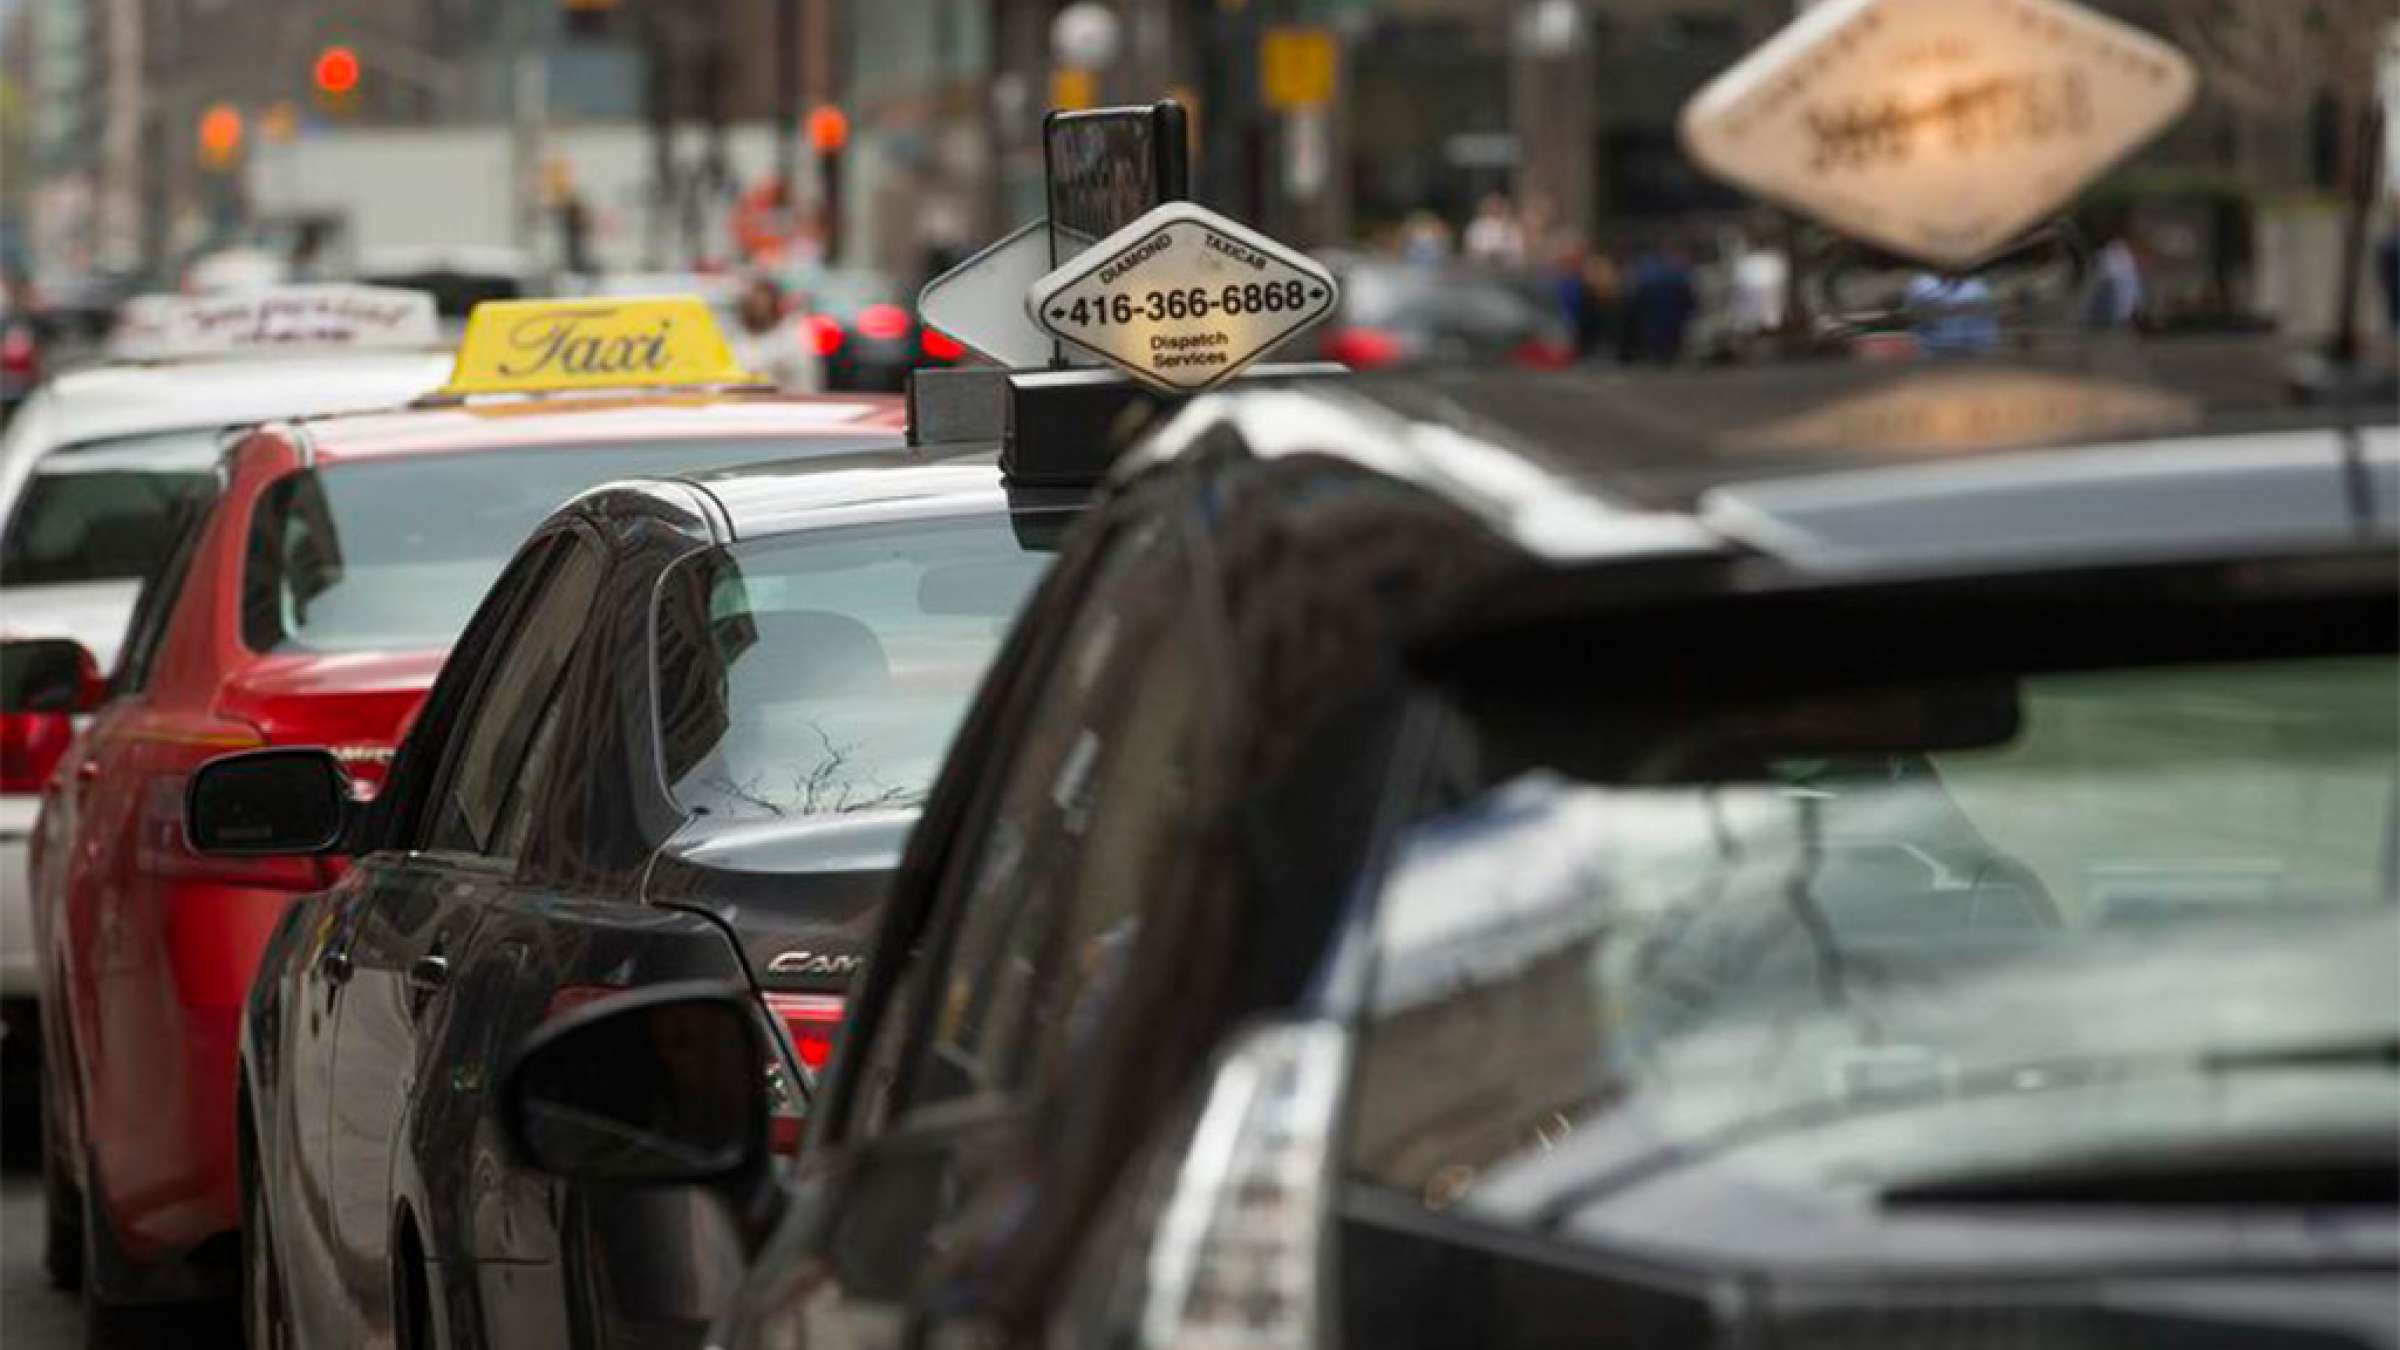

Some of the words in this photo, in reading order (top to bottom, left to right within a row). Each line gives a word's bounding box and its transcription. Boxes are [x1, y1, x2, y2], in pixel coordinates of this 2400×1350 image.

[1100, 233, 1172, 284] DIAMOND
[1205, 233, 1266, 271] TAXICAB
[1070, 279, 1304, 327] 416-366-6868
[498, 307, 674, 377] Taxi
[1151, 331, 1229, 353] Dispatch
[1153, 350, 1227, 368] Services
